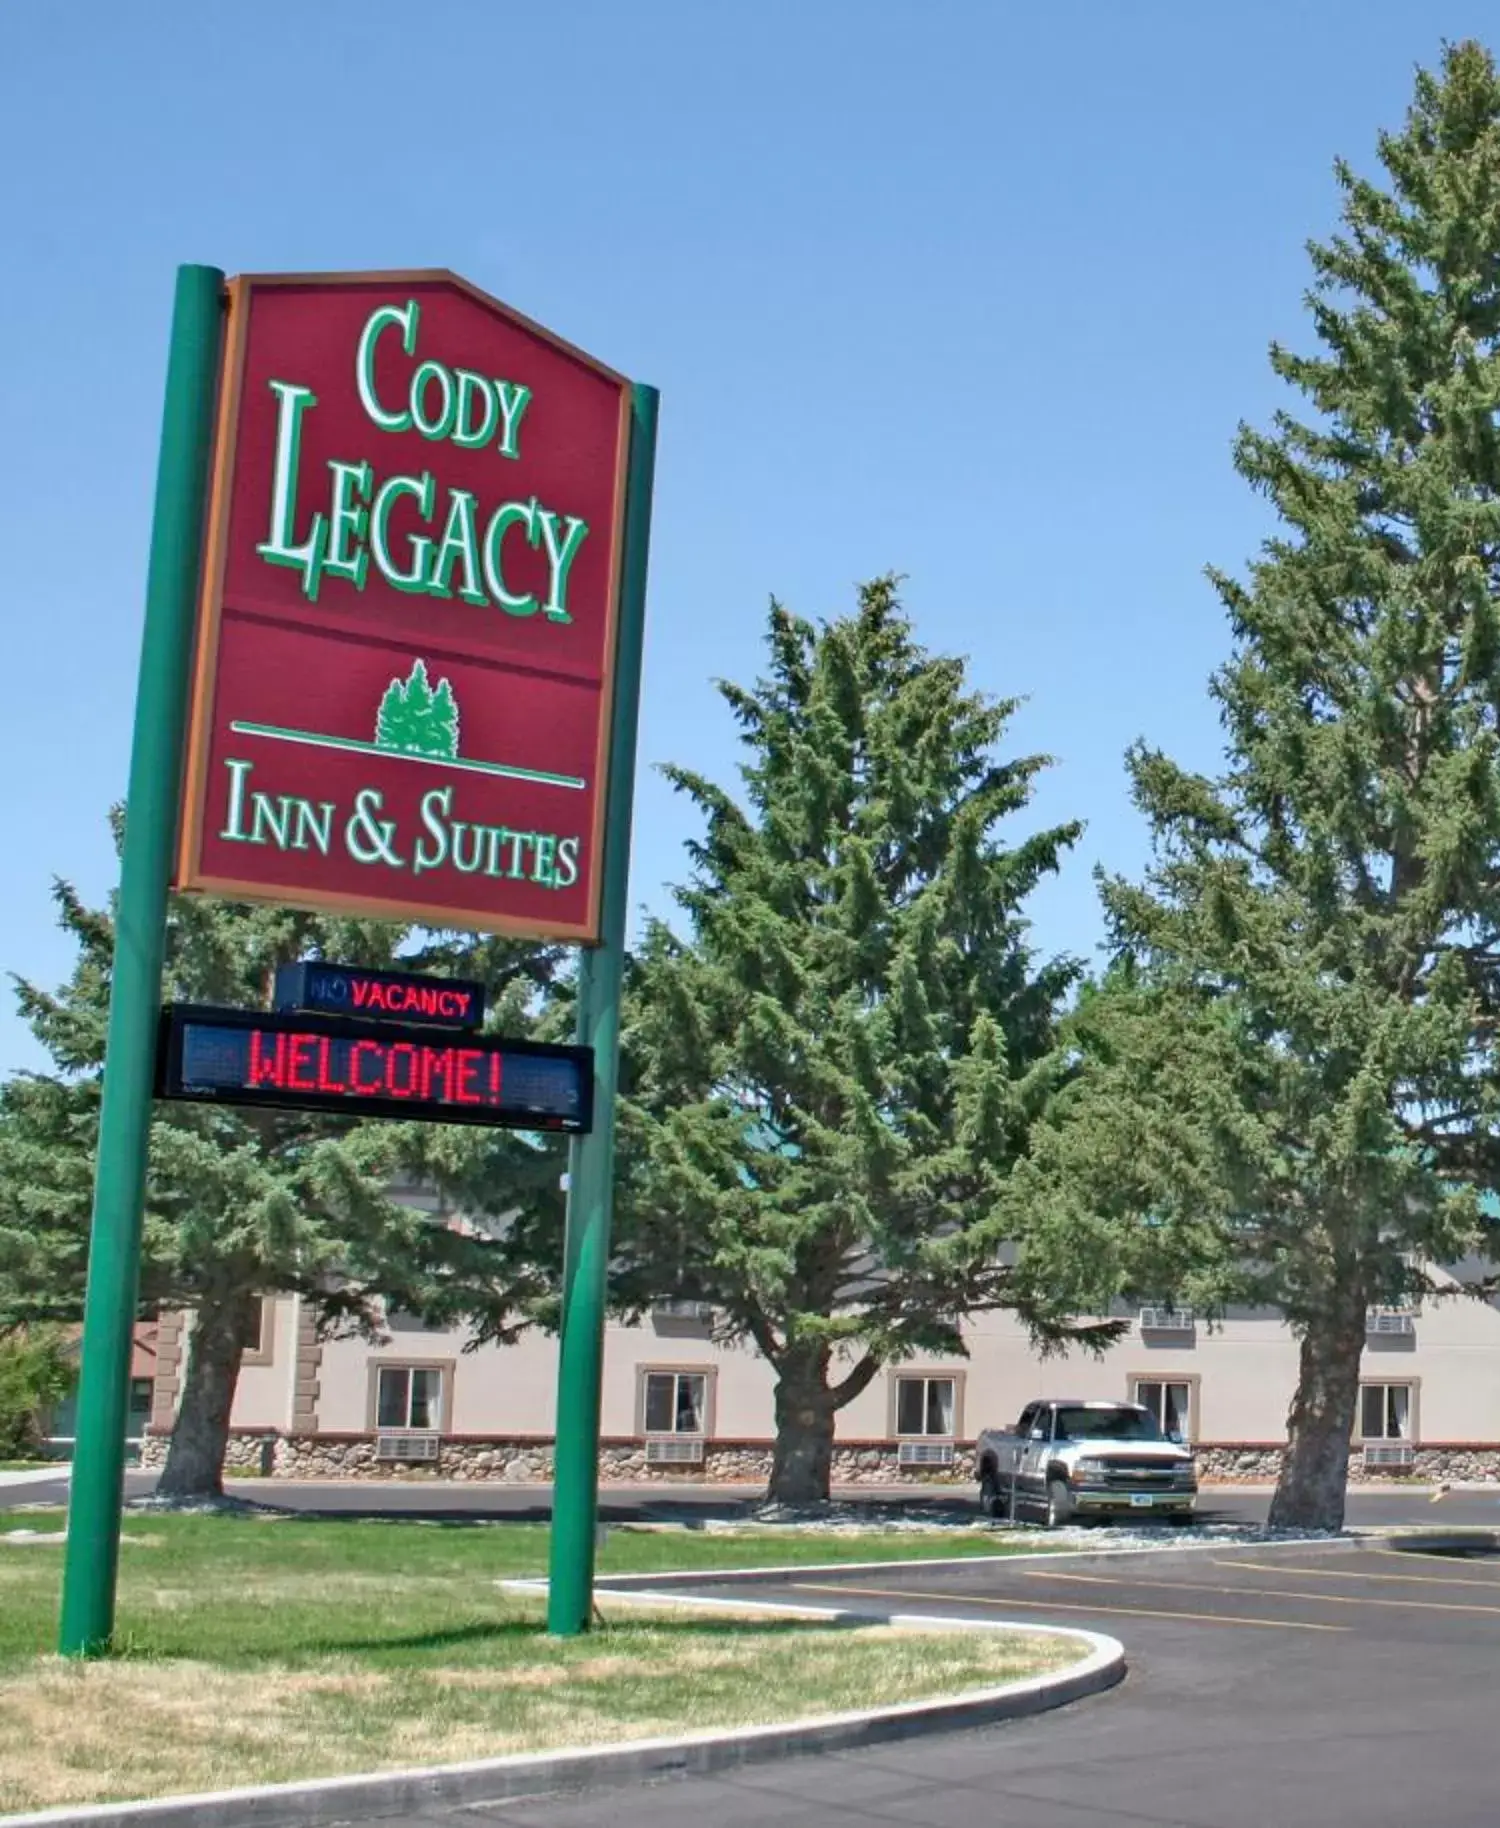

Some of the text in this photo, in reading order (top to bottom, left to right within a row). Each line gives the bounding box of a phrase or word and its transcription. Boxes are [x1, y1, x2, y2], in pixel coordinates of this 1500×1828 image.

[356, 299, 531, 459] CODY
[256, 379, 589, 623] LEGACY
[220, 758, 580, 889] INN & SUITES
[311, 975, 471, 1018] NO VACANCY
[248, 1029, 502, 1105] WELCOME!
